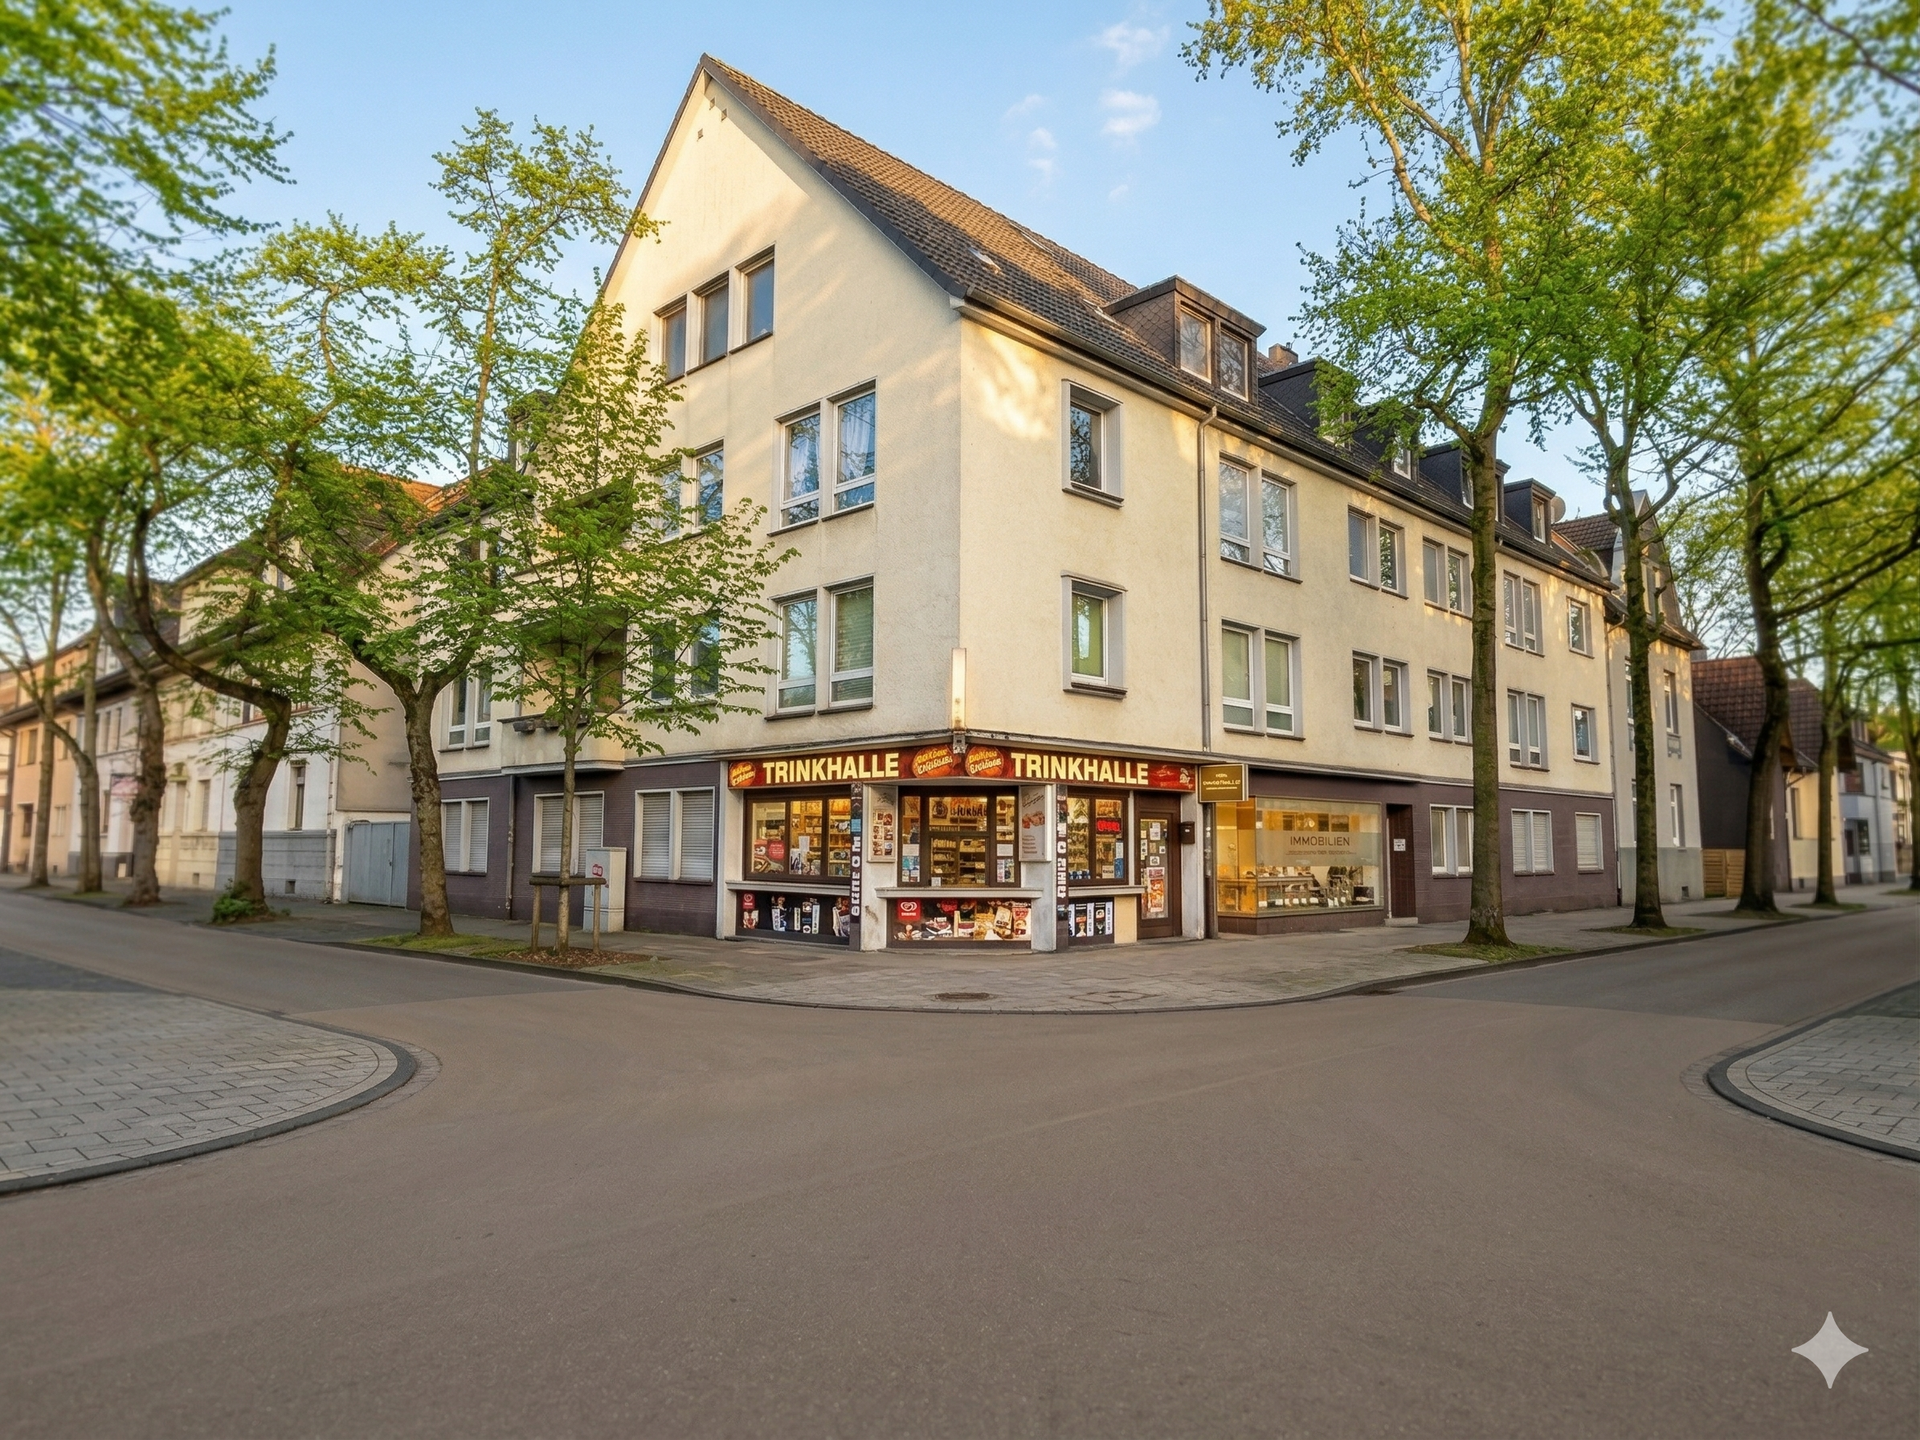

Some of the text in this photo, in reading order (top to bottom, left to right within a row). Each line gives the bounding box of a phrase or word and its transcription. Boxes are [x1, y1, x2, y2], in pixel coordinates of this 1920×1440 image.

[762, 752, 899, 784] TRINKHALLE
[1010, 752, 1149, 785] TRINKHALLE
[1290, 836, 1350, 847] IMMOBILIEN
